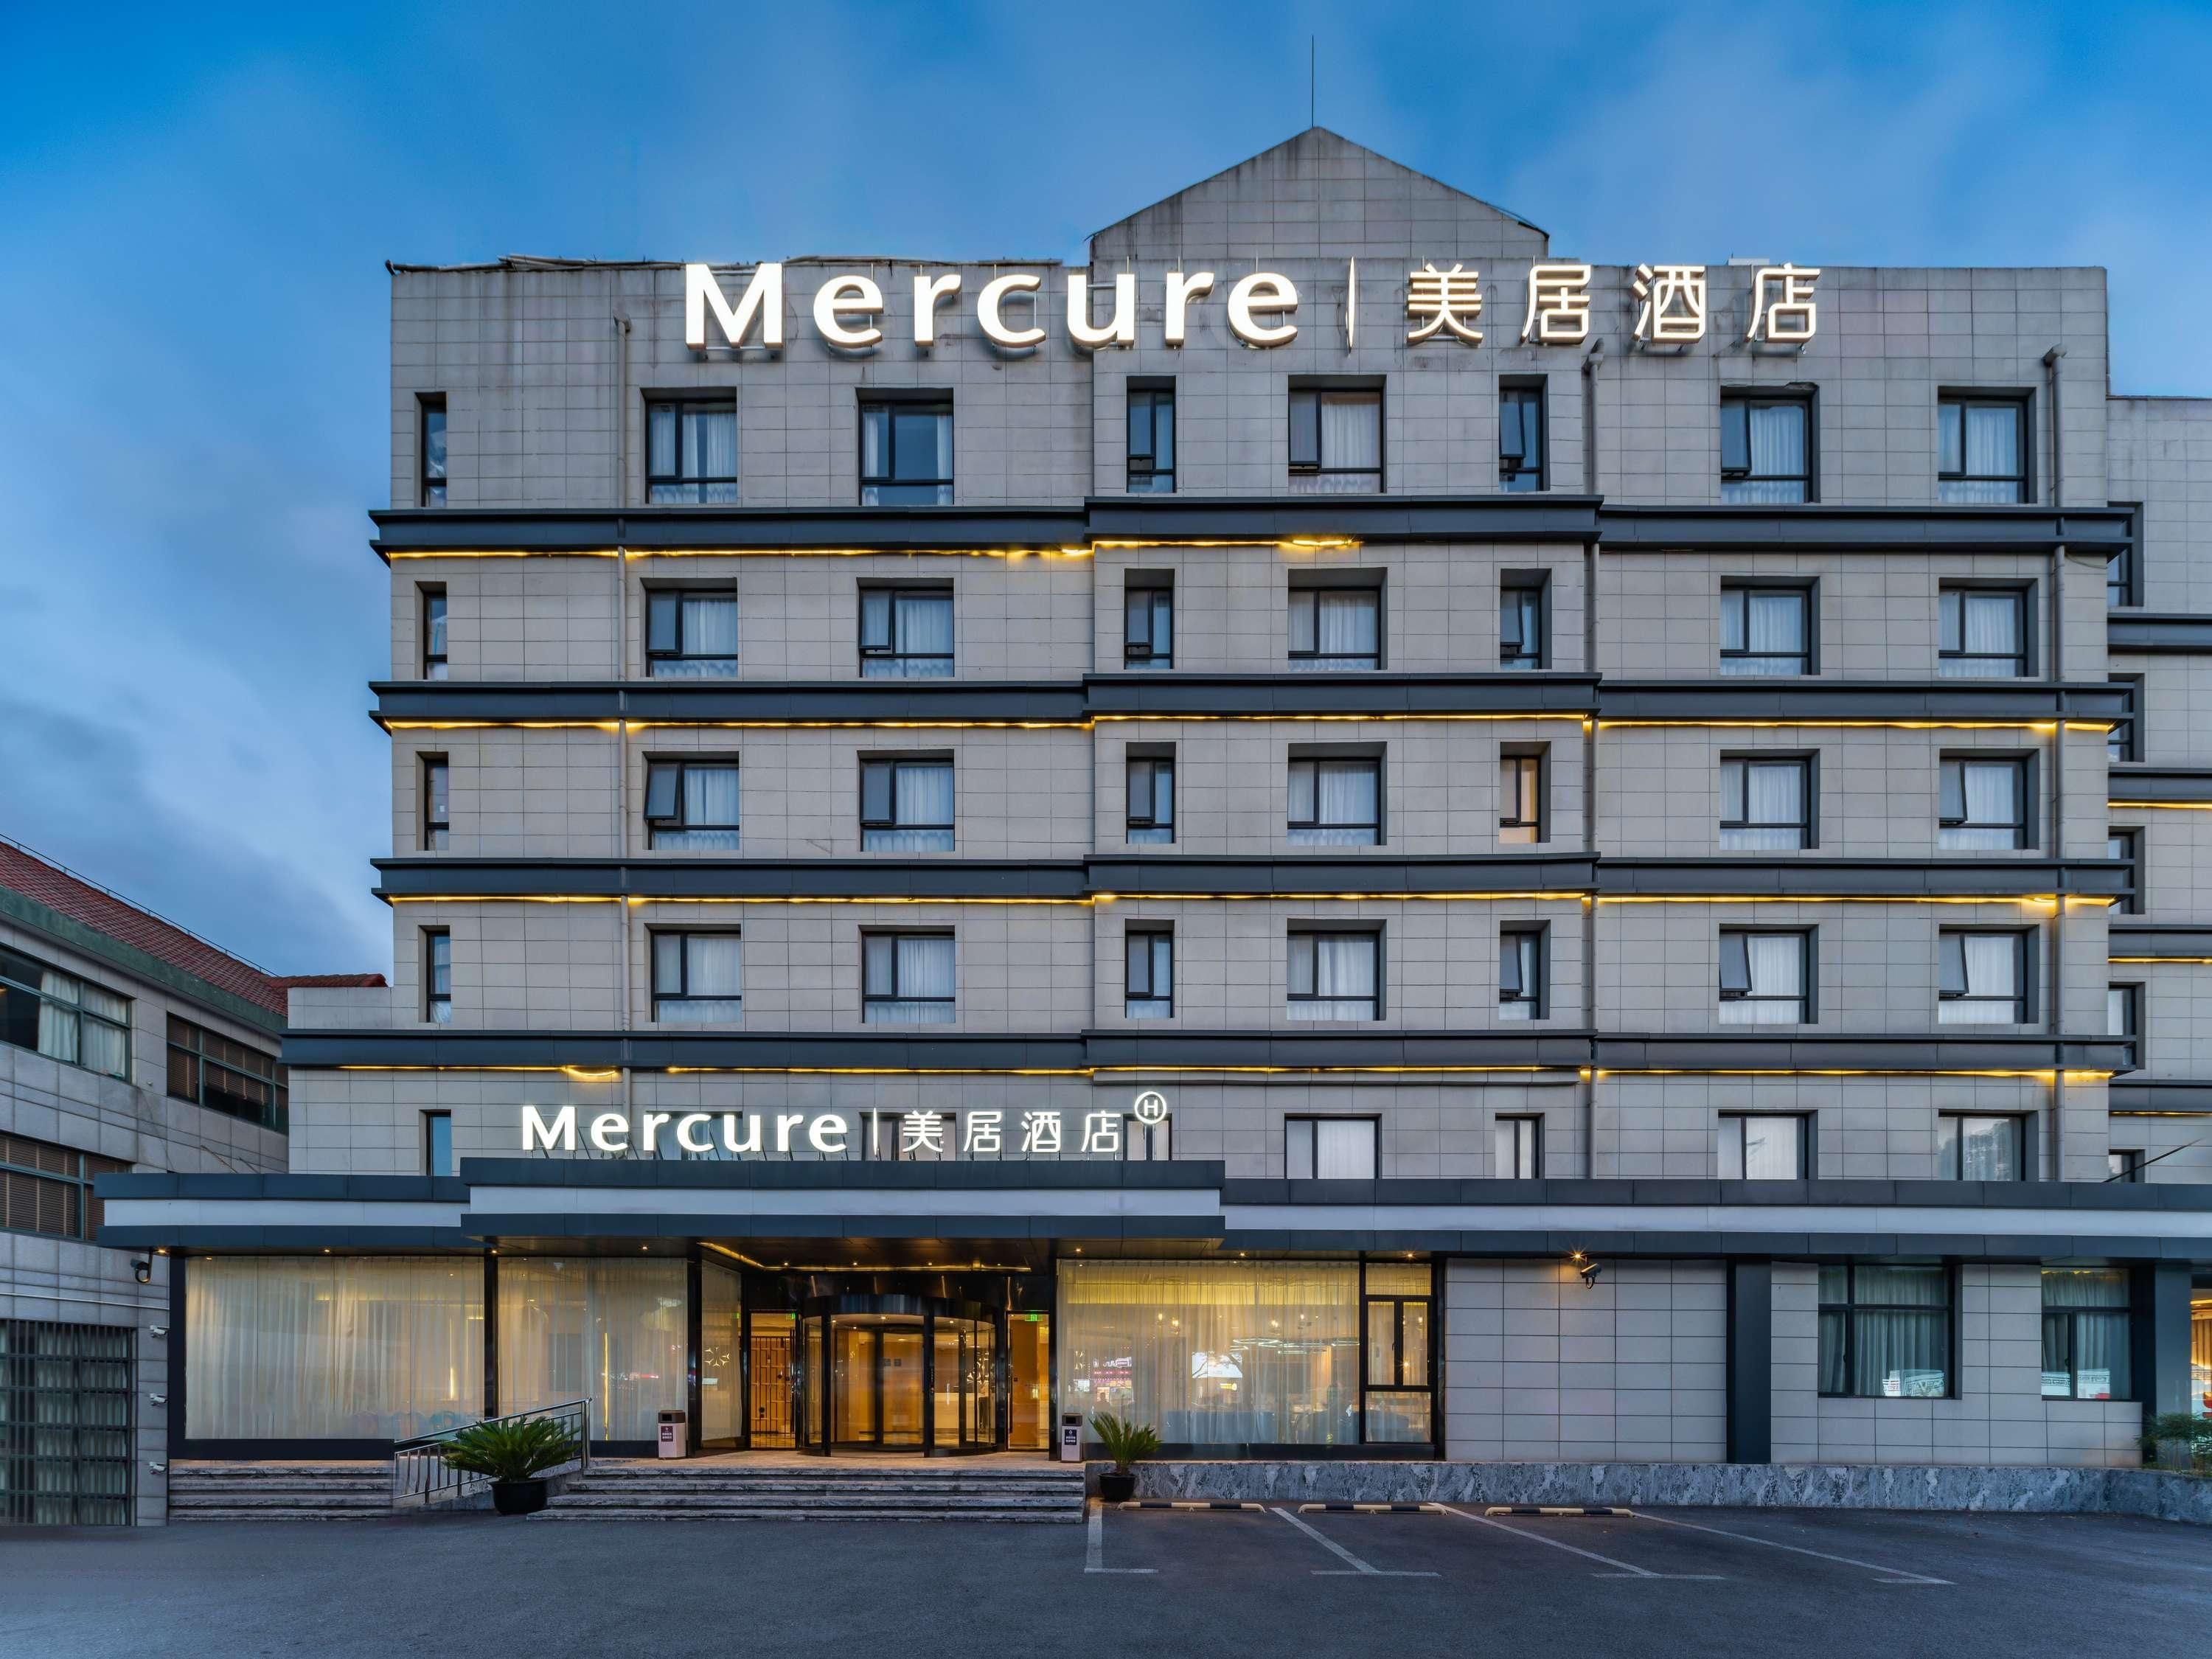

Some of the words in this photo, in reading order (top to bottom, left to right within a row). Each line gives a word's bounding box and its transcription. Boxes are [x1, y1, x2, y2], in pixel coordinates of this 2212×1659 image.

[685, 263, 1299, 349] Mercure
[1407, 262, 1821, 344] 美居酒店
[522, 1105, 848, 1152] Mercure
[901, 1110, 1122, 1153] 美居酒店
